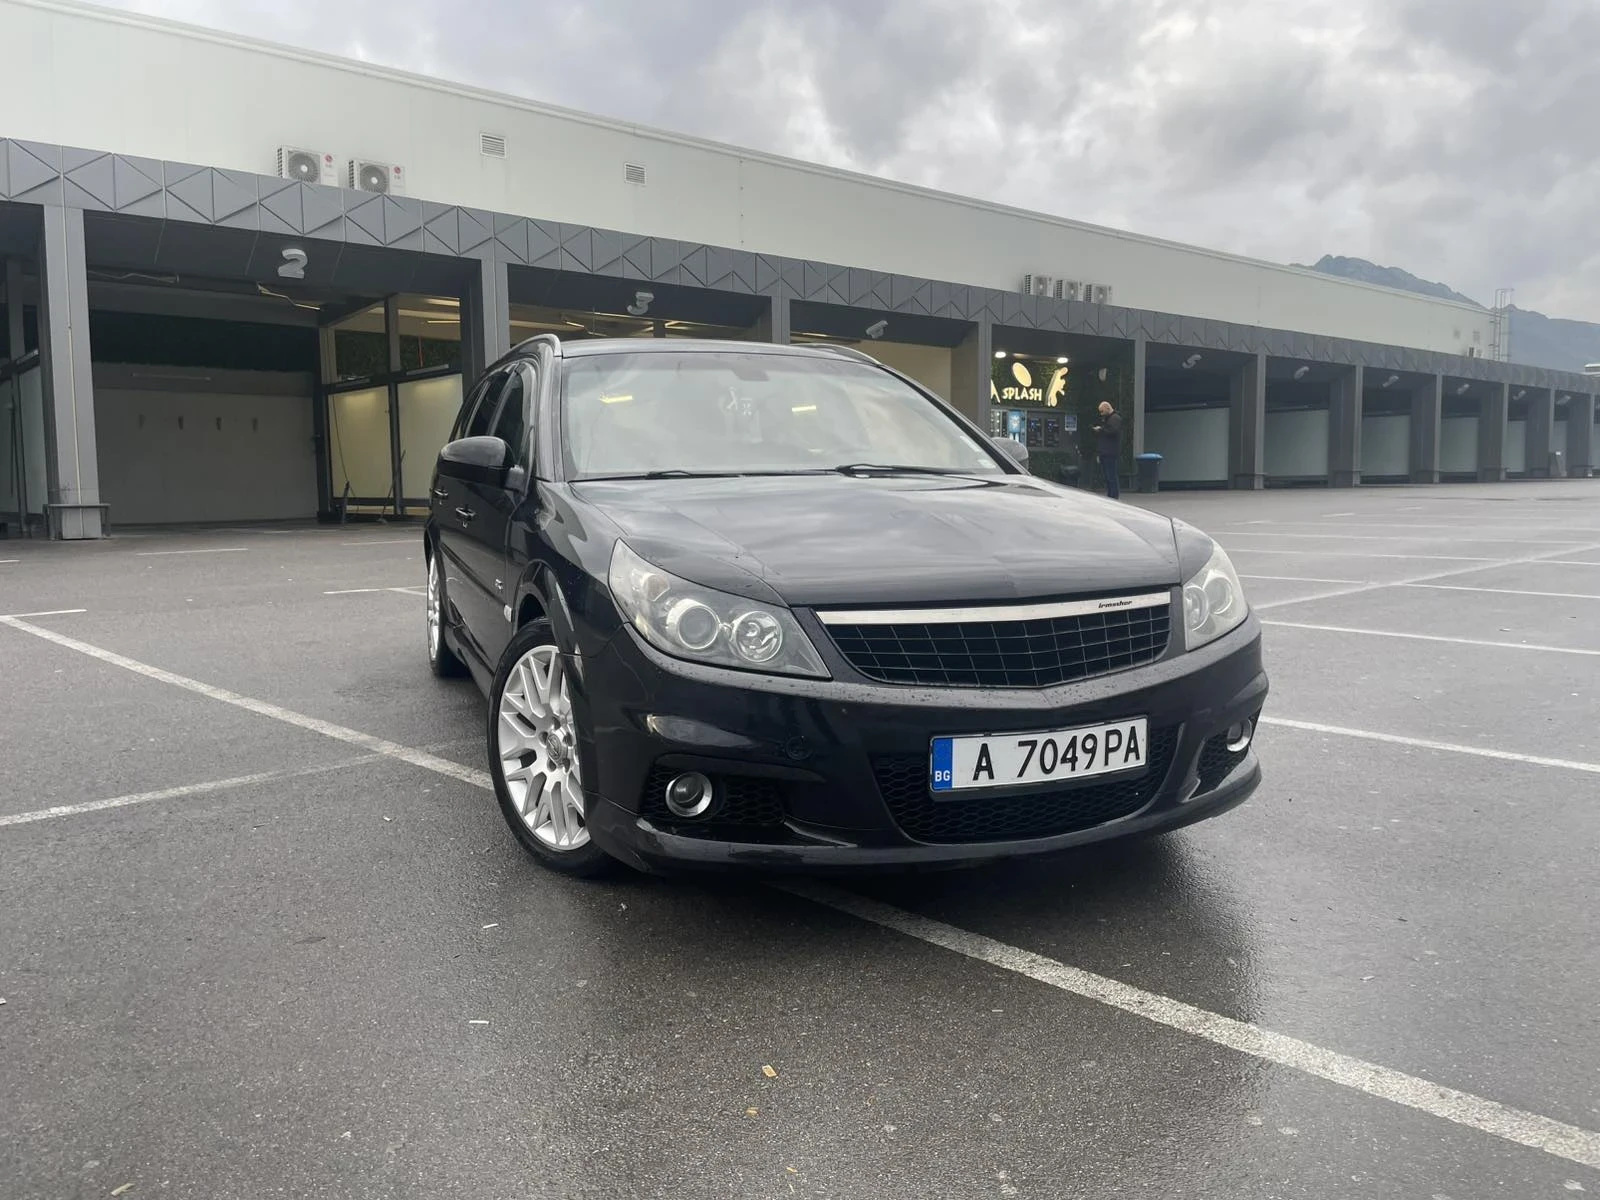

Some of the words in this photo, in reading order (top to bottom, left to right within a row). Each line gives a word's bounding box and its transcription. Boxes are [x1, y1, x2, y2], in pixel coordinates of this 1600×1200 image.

[278, 248, 308, 279] 2
[627, 292, 654, 315] 3
[1002, 387, 1042, 401] SPLASH
[972, 743, 995, 780] A
[935, 771, 950, 782] BG
